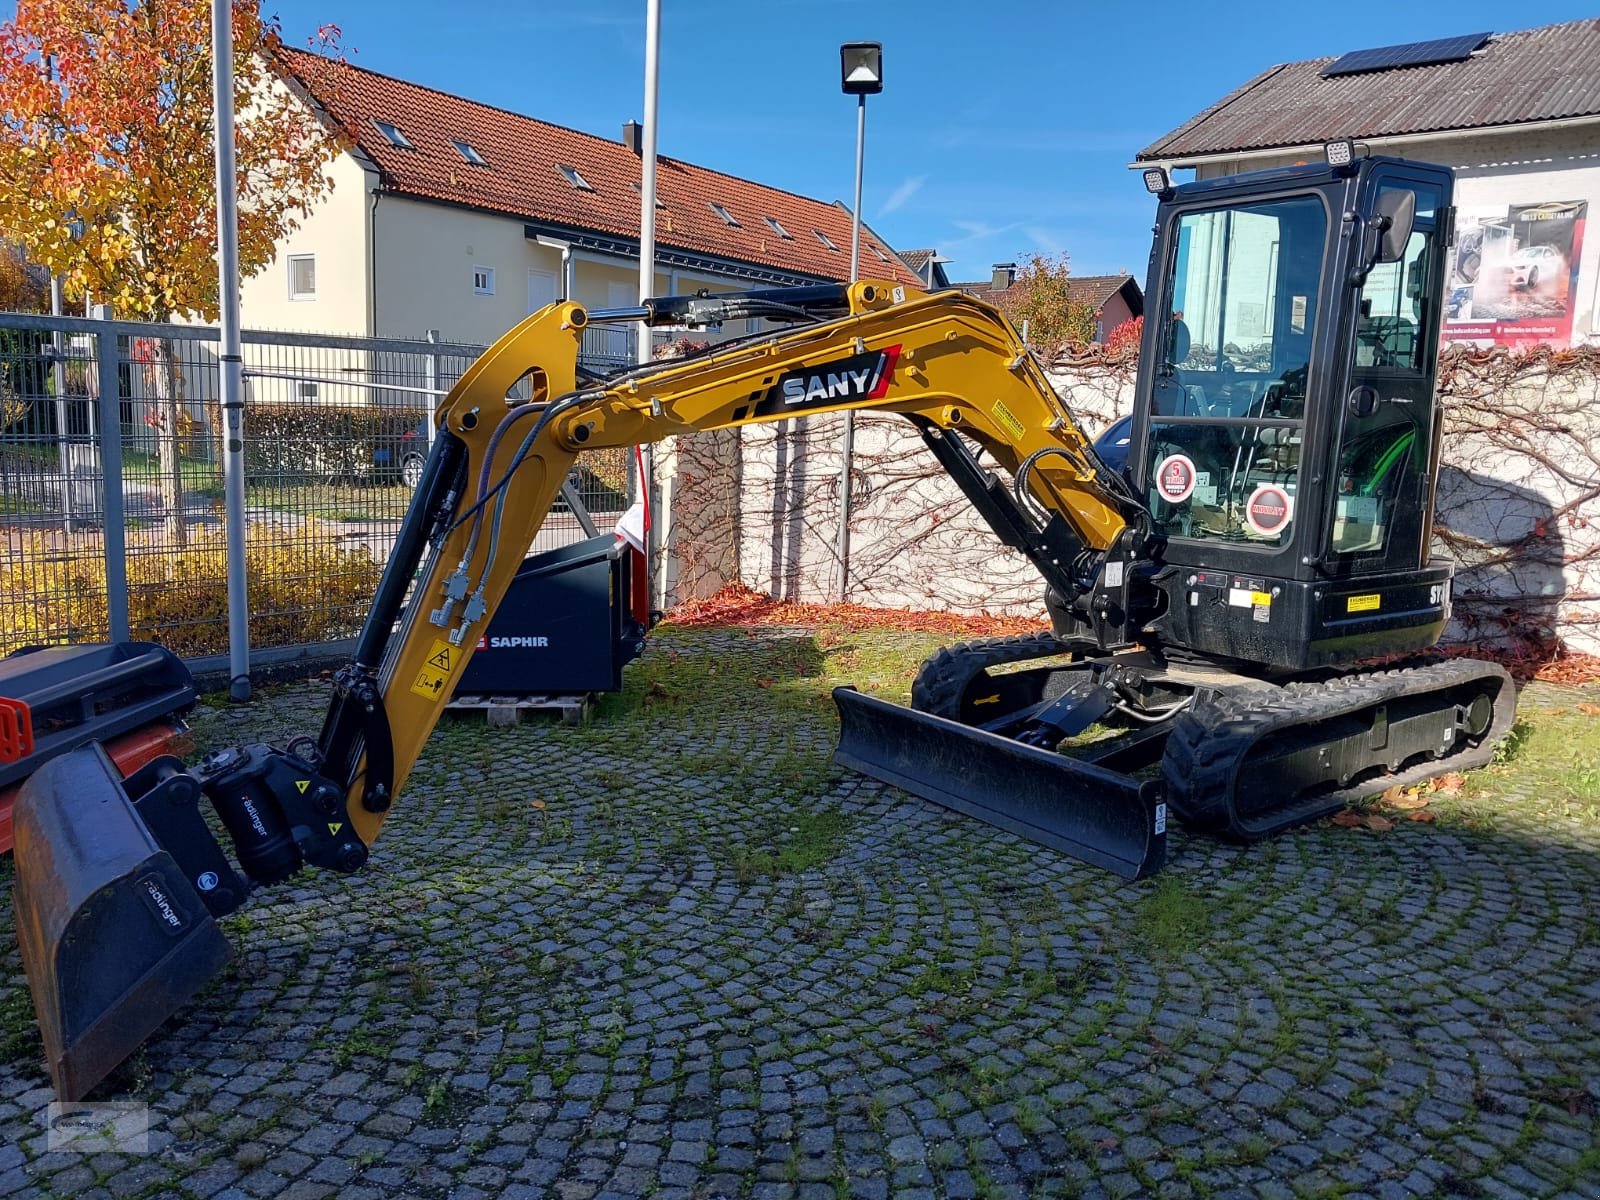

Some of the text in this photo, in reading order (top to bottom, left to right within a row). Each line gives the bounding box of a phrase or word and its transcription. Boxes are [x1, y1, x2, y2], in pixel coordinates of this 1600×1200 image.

[783, 367, 871, 405] SANY
[1172, 462, 1180, 476] 5
[490, 636, 549, 648] SAPHIR
